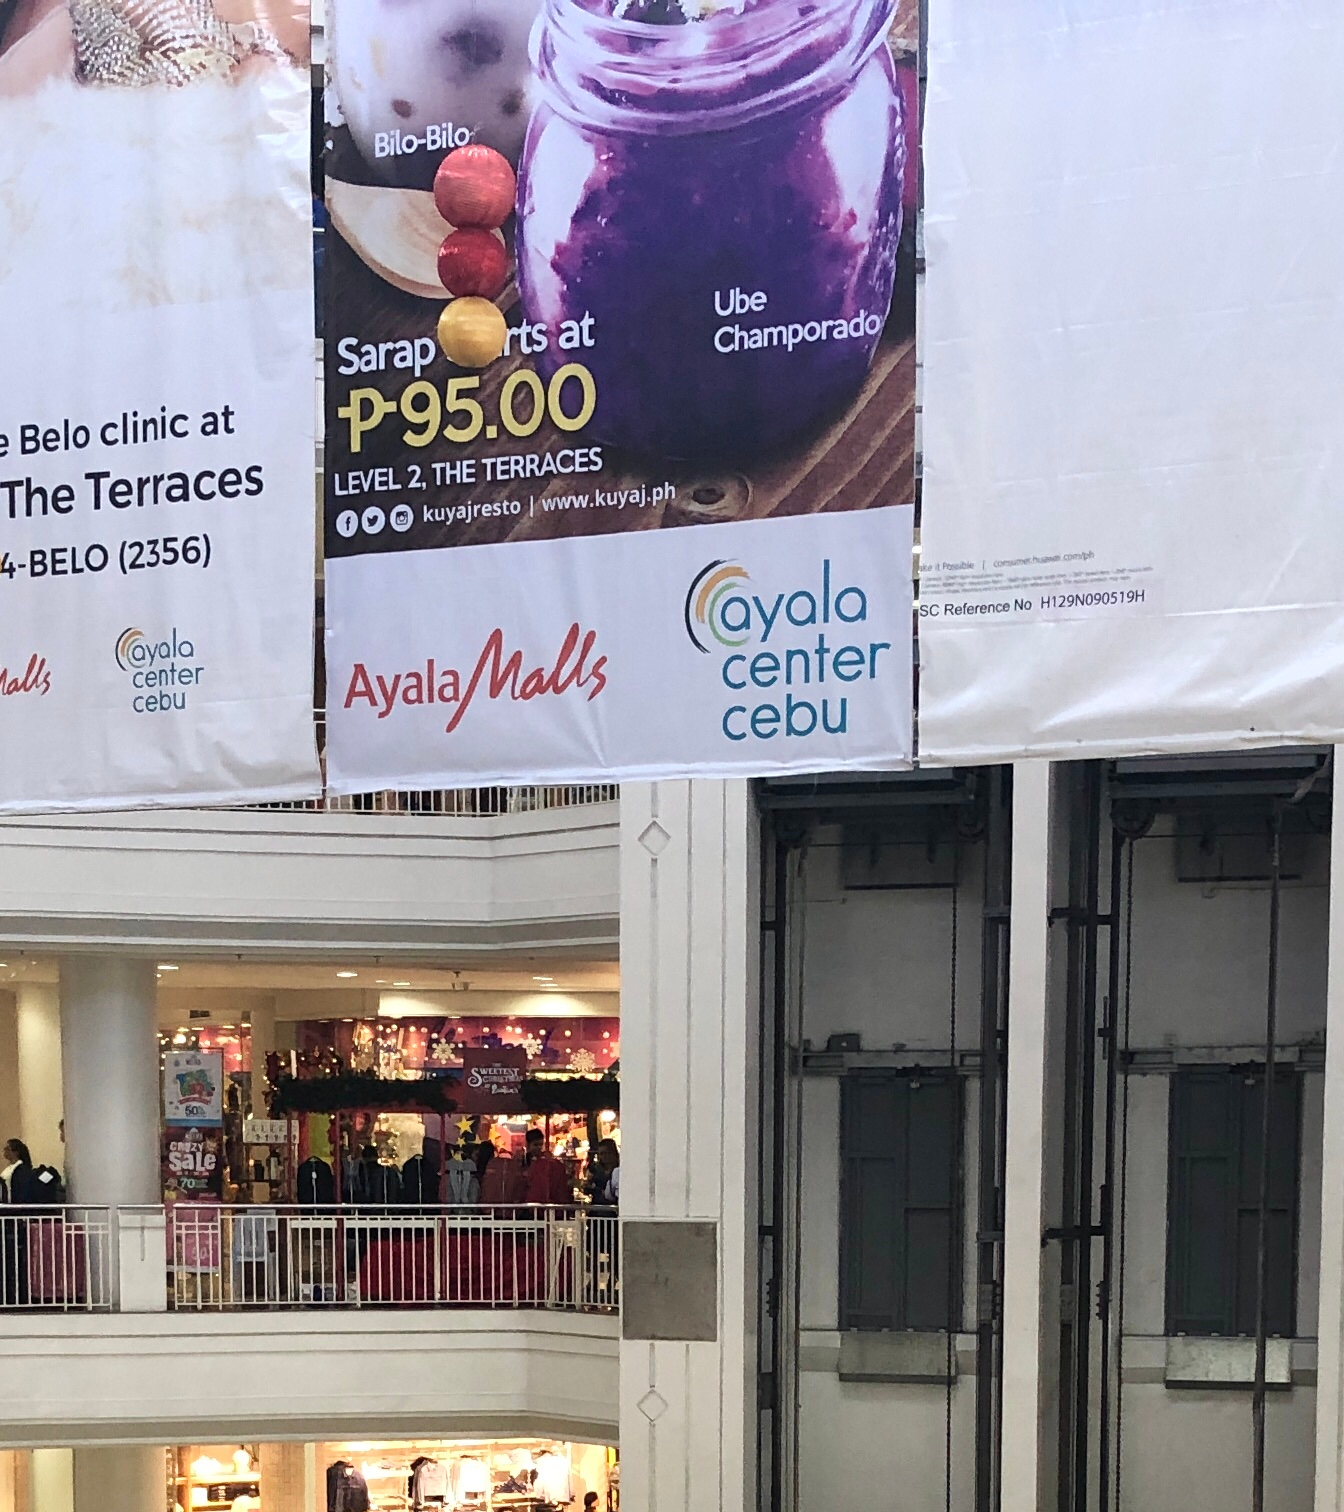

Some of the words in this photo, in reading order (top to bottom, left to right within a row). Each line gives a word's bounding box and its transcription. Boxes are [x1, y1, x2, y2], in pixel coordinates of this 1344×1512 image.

[374, 123, 470, 158] Bilo-Bilo
[714, 288, 768, 316] Ube
[337, 336, 436, 377] Sarap
[559, 311, 595, 350] at
[714, 311, 881, 354] Champorado
[20, 419, 90, 455] Belo
[100, 406, 188, 446] clinic
[200, 405, 234, 436] at
[0, 477, 75, 519] The
[85, 463, 264, 511] Terraces
[335, 466, 402, 497] LEVEL
[407, 464, 427, 490] 2,
[432, 460, 476, 486] THE
[482, 446, 603, 481] TERRACES
[423, 499, 521, 525] kuyajresto
[542, 482, 677, 514] www.kuyaj.ph
[119, 534, 211, 575] (2356)
[721, 559, 867, 643] ayala
[919, 603, 939, 617] SC
[944, 602, 1010, 616] Reference
[1014, 599, 1032, 611] No
[1041, 589, 1145, 609] H129N090519H
[129, 627, 195, 667] ayala
[722, 630, 891, 691] center
[132, 663, 205, 690] center
[132, 688, 187, 713] cebu
[722, 690, 849, 741] cebu
[468, 1067, 519, 1087] SWEETEST
